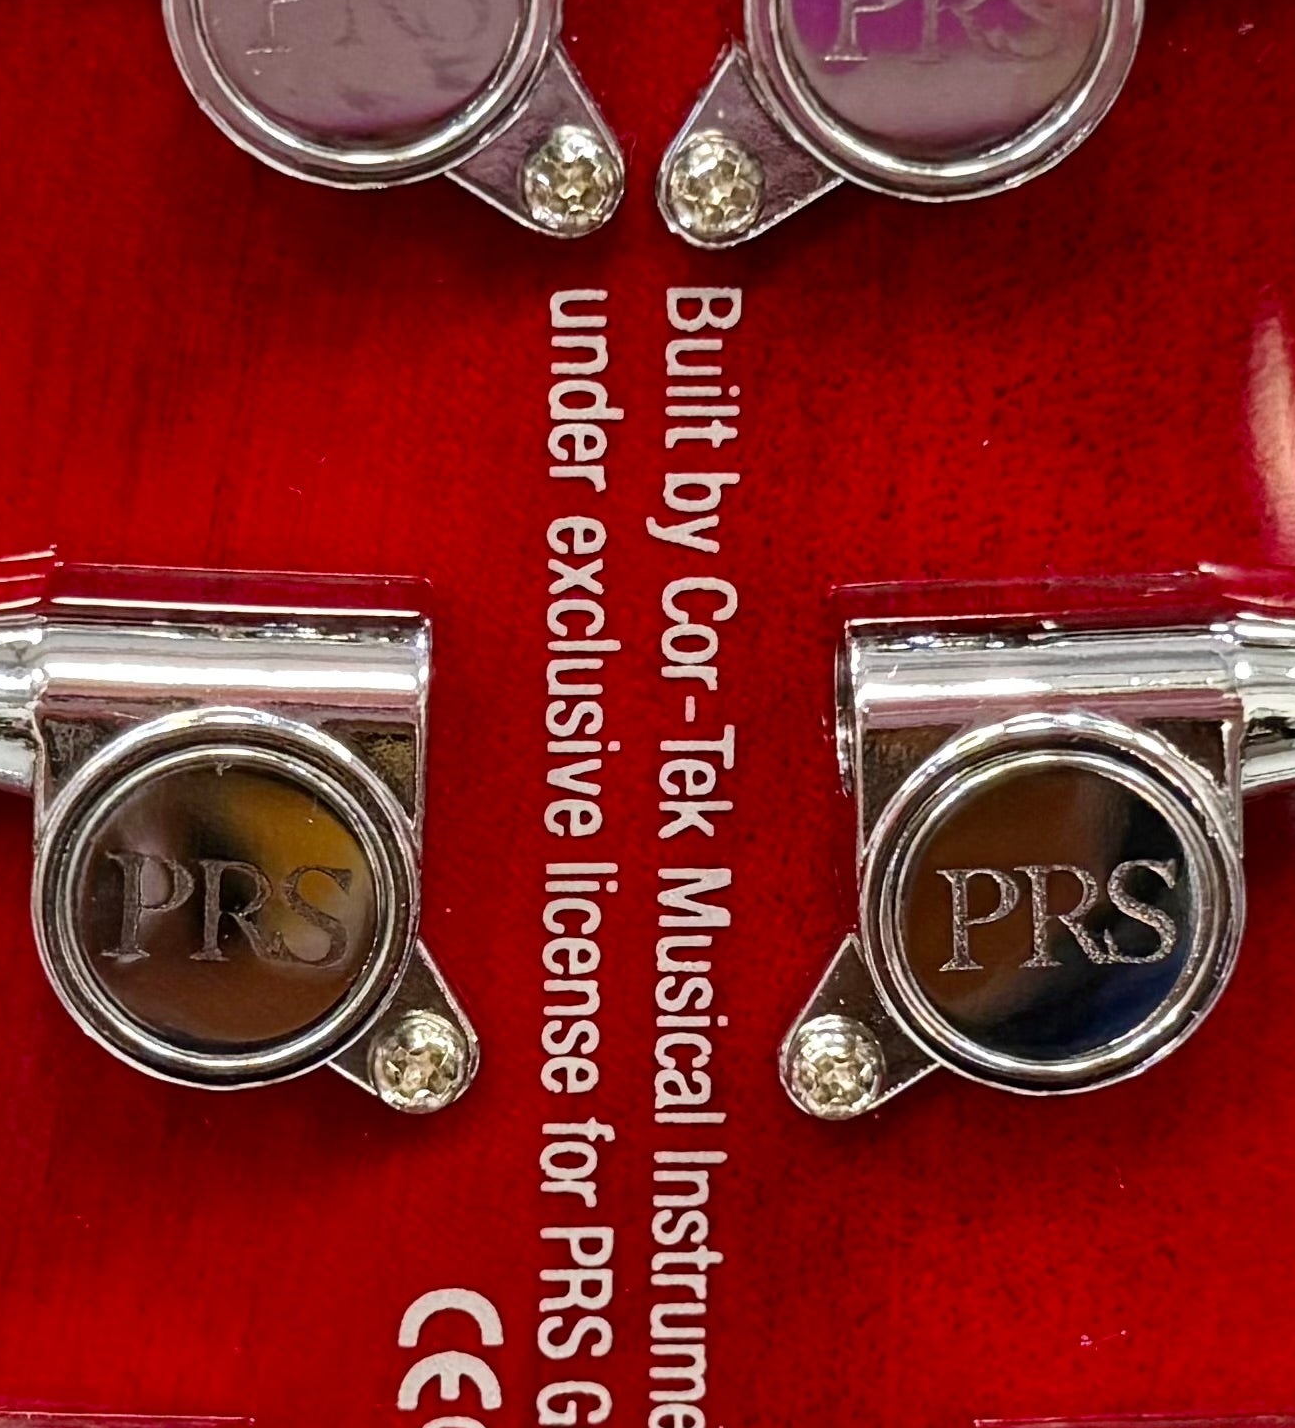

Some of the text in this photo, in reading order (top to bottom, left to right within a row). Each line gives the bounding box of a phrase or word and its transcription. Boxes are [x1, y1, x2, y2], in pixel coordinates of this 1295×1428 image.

[546, 287, 626, 494] under
[663, 286, 744, 450] Built
[644, 471, 742, 555] by
[542, 514, 624, 838] exclusive
[656, 575, 739, 840] Cor-Tek
[106, 850, 354, 968] PRS
[539, 861, 620, 1095] license
[936, 856, 1183, 973] PRS
[652, 866, 733, 1125] Musical
[538, 1115, 617, 1209] for
[536, 1225, 616, 1361] PRS
